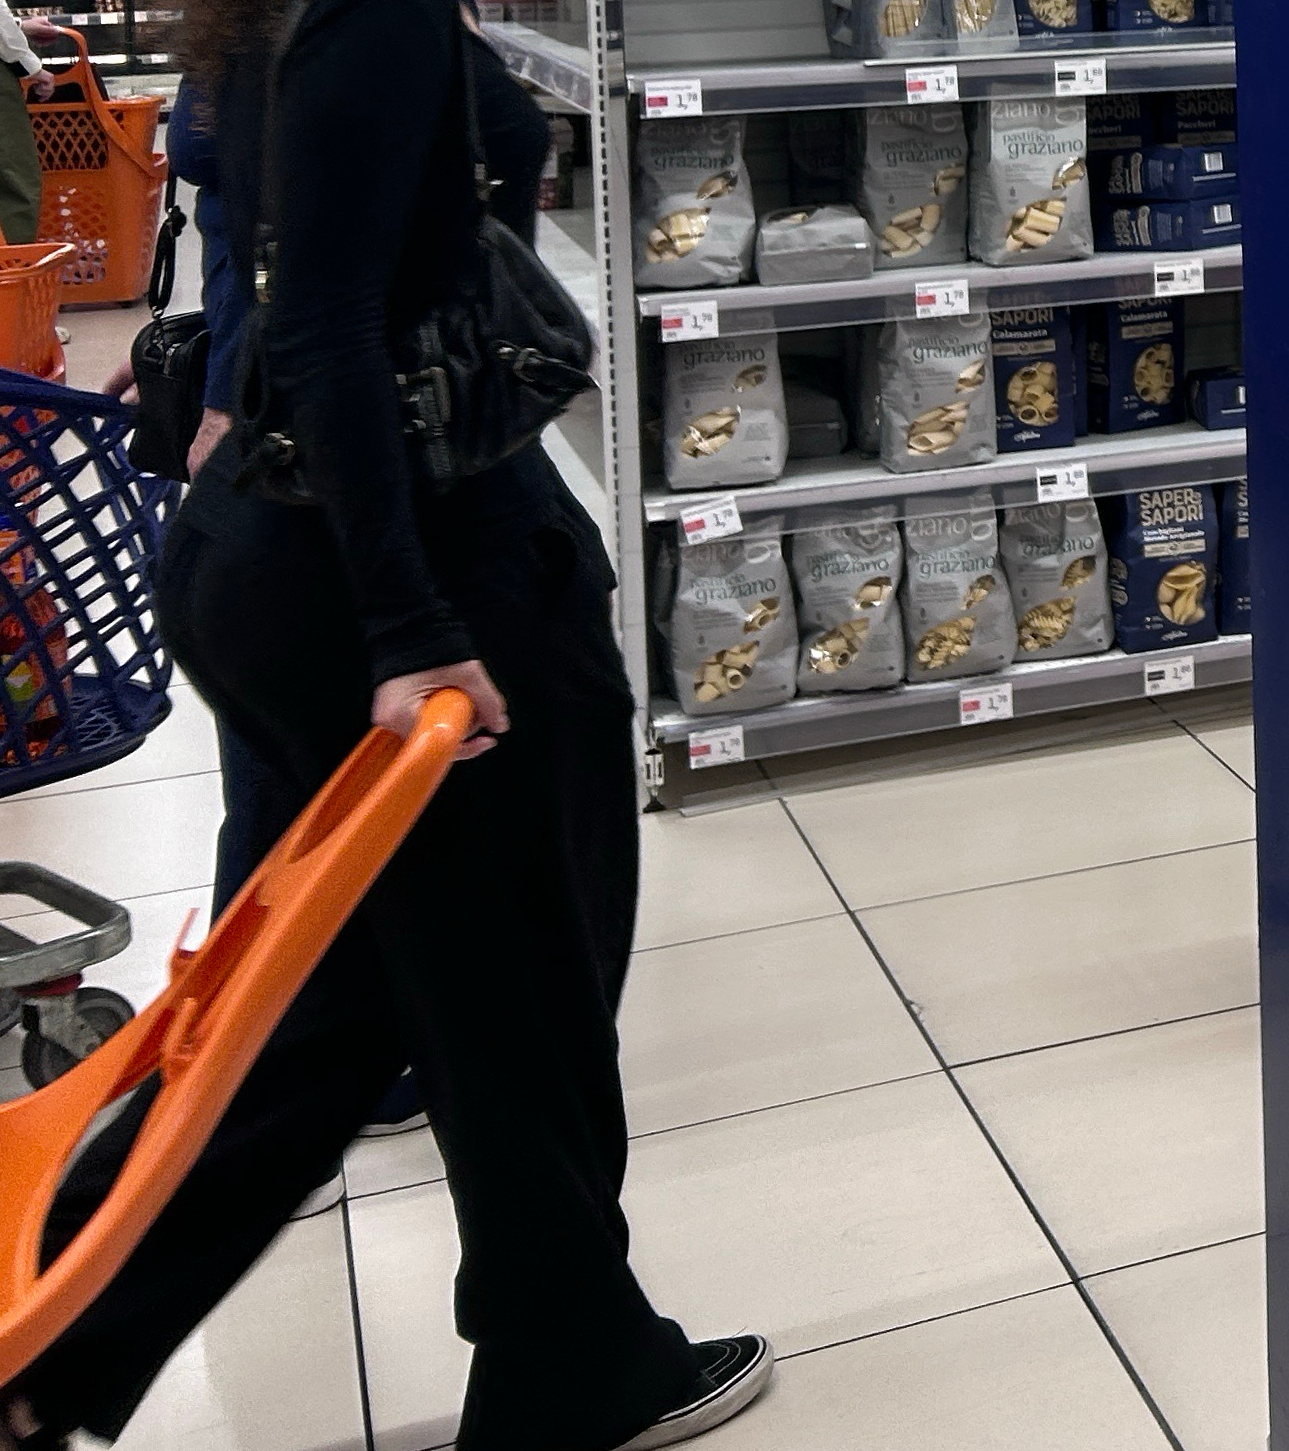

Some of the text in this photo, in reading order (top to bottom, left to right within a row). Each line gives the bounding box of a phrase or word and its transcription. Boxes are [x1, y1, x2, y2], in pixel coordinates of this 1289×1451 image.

[886, 146, 962, 167] graziano
[1008, 139, 1083, 158] graziano
[991, 308, 1053, 326] SAPORI
[1139, 489, 1194, 510] SAPER
[1141, 505, 1203, 527] SAPORI
